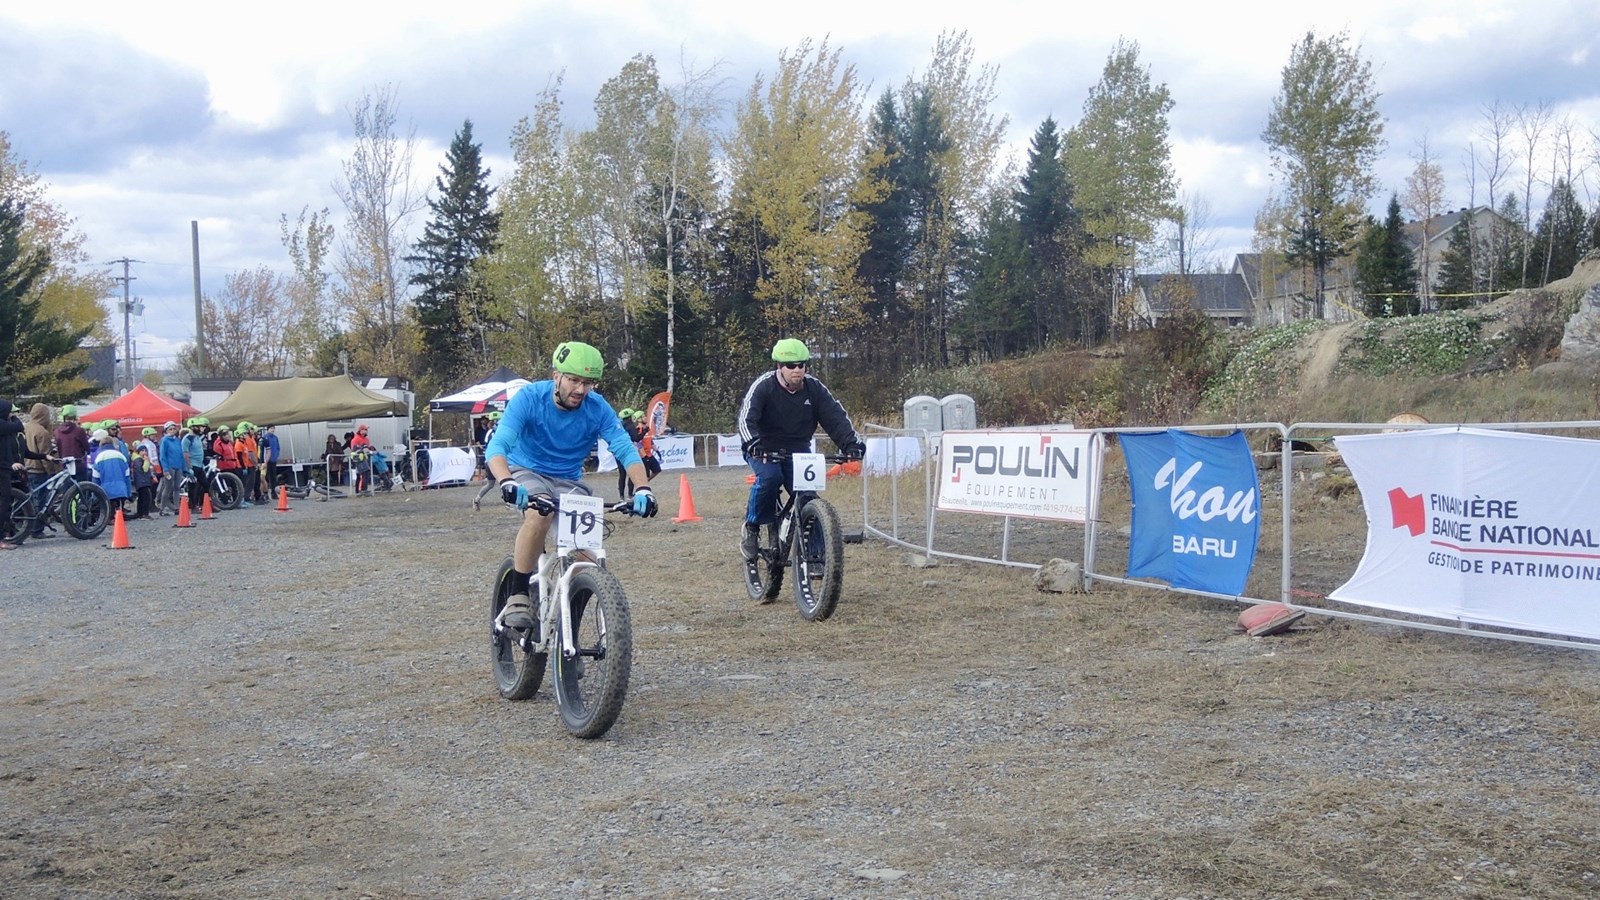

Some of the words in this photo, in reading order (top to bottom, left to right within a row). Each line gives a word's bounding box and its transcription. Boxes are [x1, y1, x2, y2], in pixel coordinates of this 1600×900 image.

[556, 345, 571, 364] 19
[952, 438, 1080, 481] POULIN
[804, 464, 816, 482] 6
[966, 483, 1058, 500] ÉQUIPEMENT
[566, 510, 596, 535] 19
